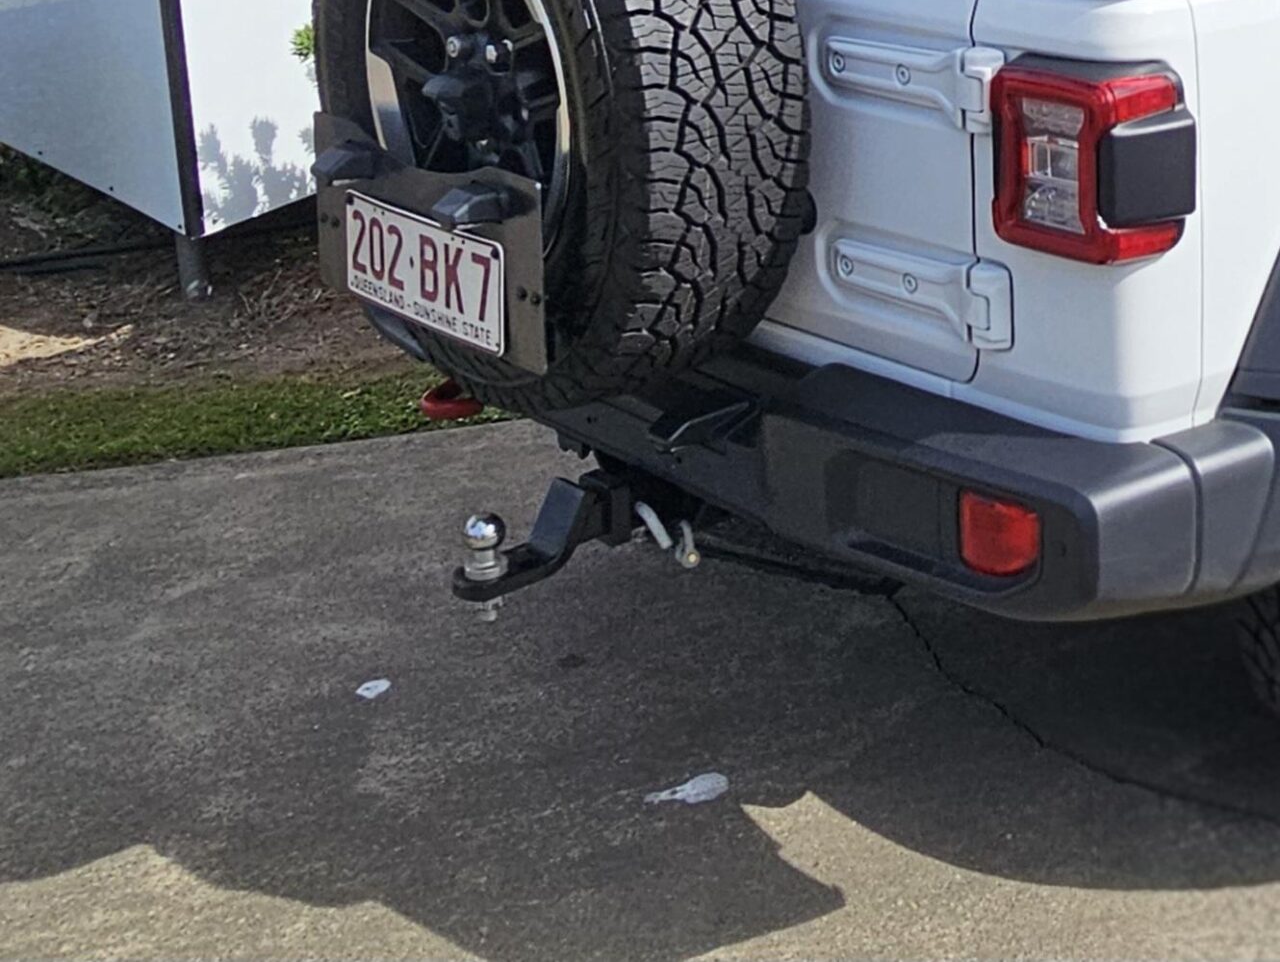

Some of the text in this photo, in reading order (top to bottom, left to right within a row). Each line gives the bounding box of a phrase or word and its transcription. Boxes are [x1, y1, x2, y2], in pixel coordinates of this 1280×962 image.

[350, 274, 405, 311] QUEENSLAND
[413, 300, 458, 333] SUNSHINE
[461, 321, 492, 346] STATE
[351, 209, 492, 322] 202 BK7
